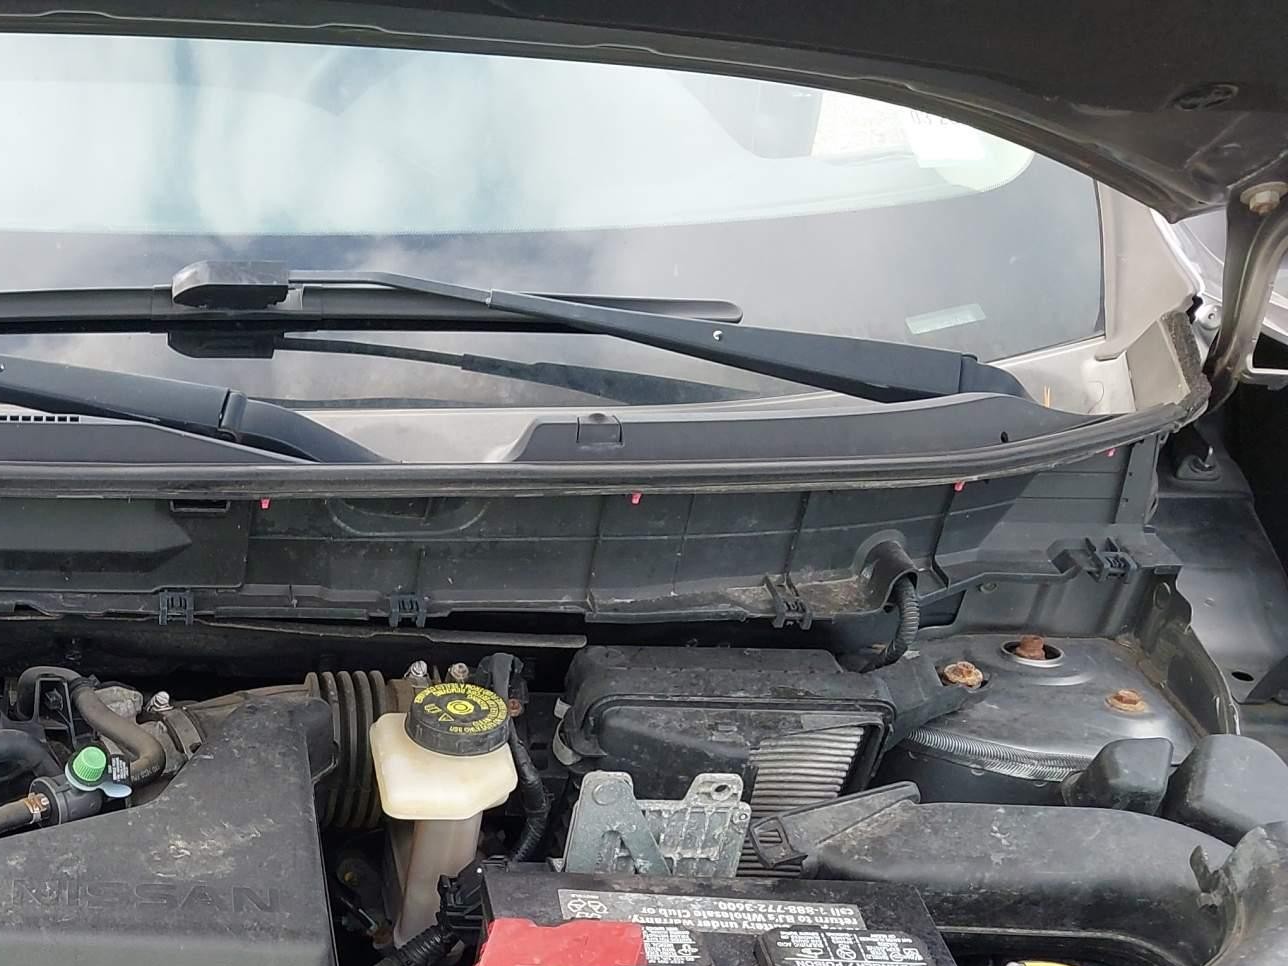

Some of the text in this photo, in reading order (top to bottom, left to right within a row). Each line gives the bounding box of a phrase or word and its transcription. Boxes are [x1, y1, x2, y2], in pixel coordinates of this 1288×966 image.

[11, 878, 281, 913] NISSAN
[641, 906, 859, 925] return to BJ's Wholesale Club or
[830, 906, 855, 916] call
[695, 917, 738, 929] under
